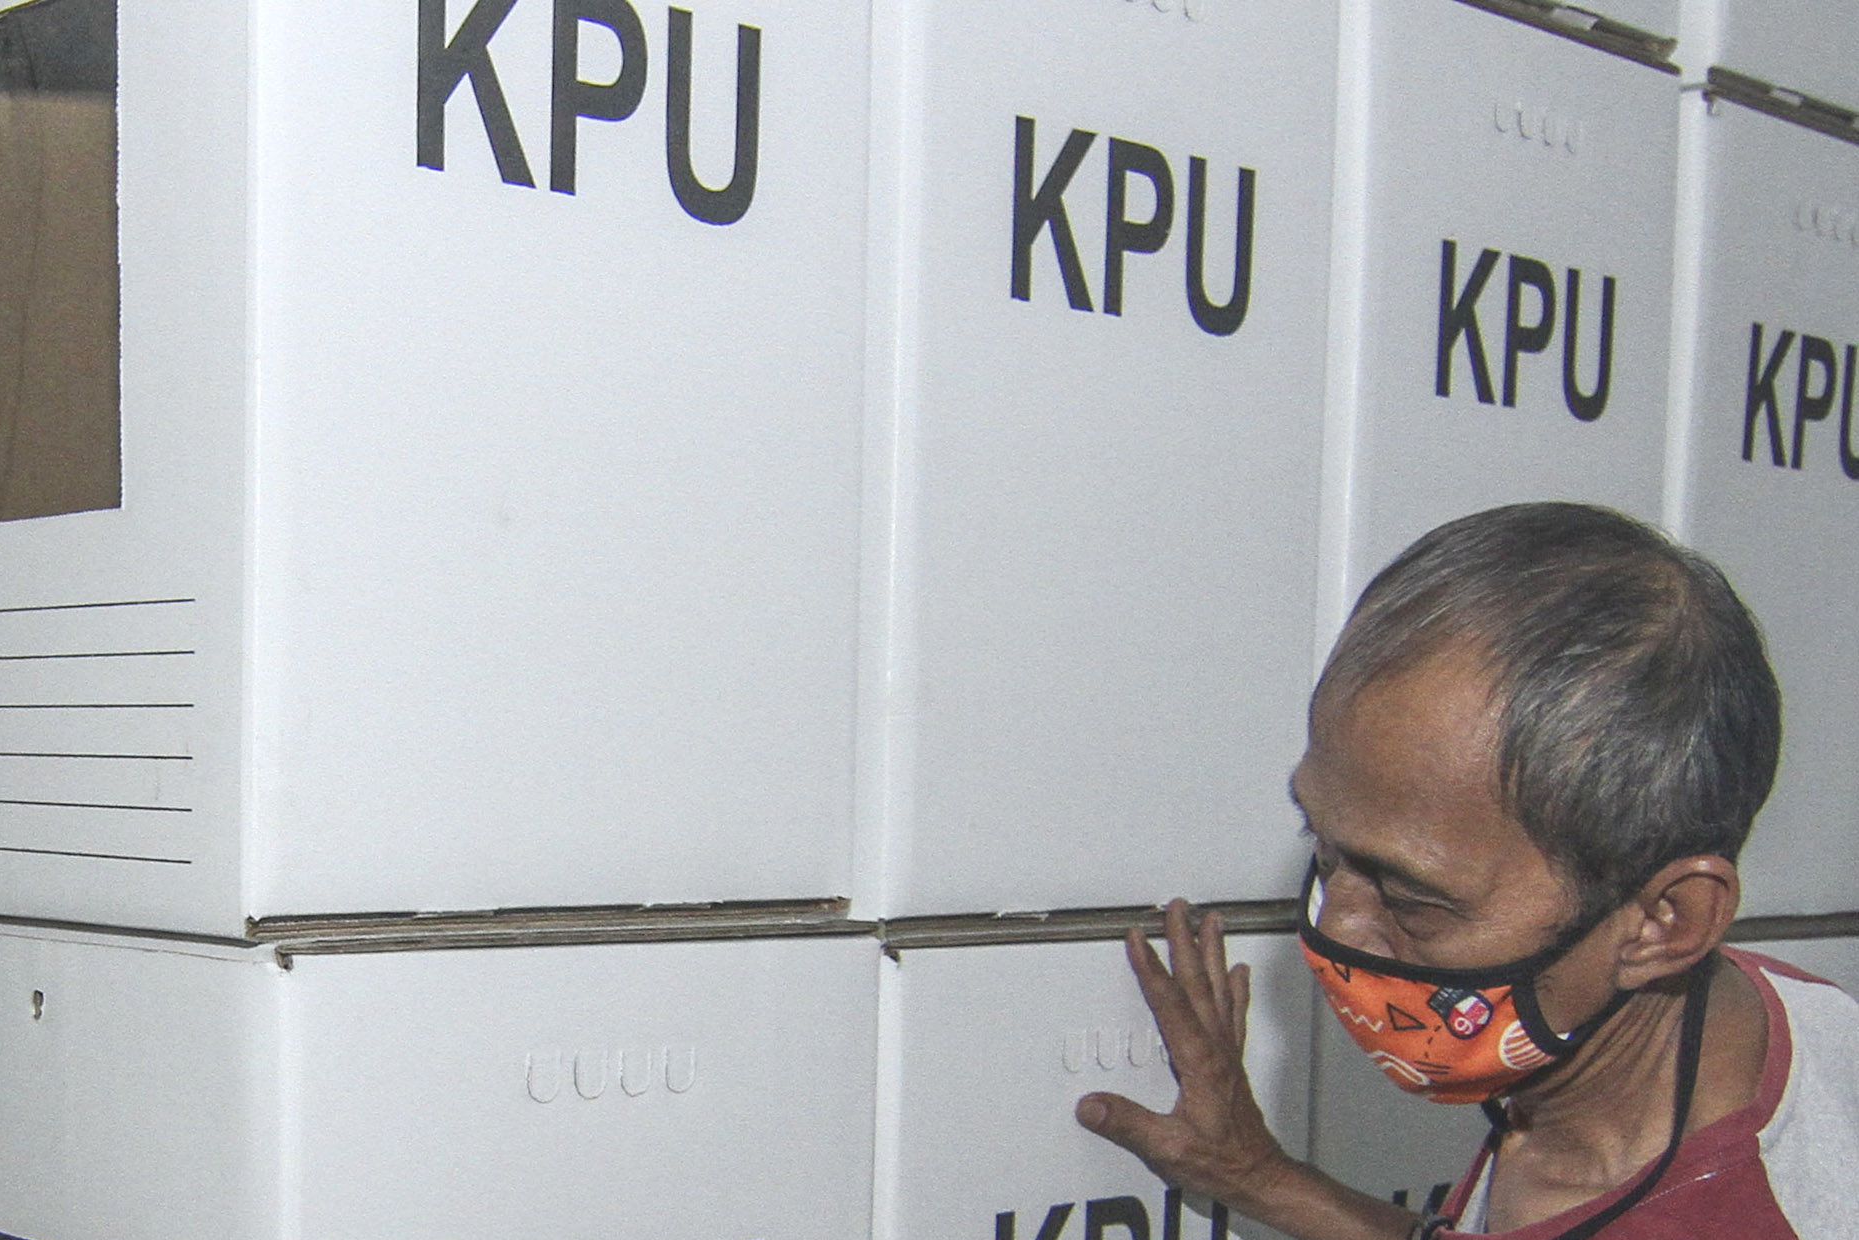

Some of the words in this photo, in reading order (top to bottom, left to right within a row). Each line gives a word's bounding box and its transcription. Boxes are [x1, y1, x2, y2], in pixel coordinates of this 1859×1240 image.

[415, 0, 761, 226] KPU
[1011, 115, 1255, 337] KPU
[1436, 239, 1616, 422] KPU
